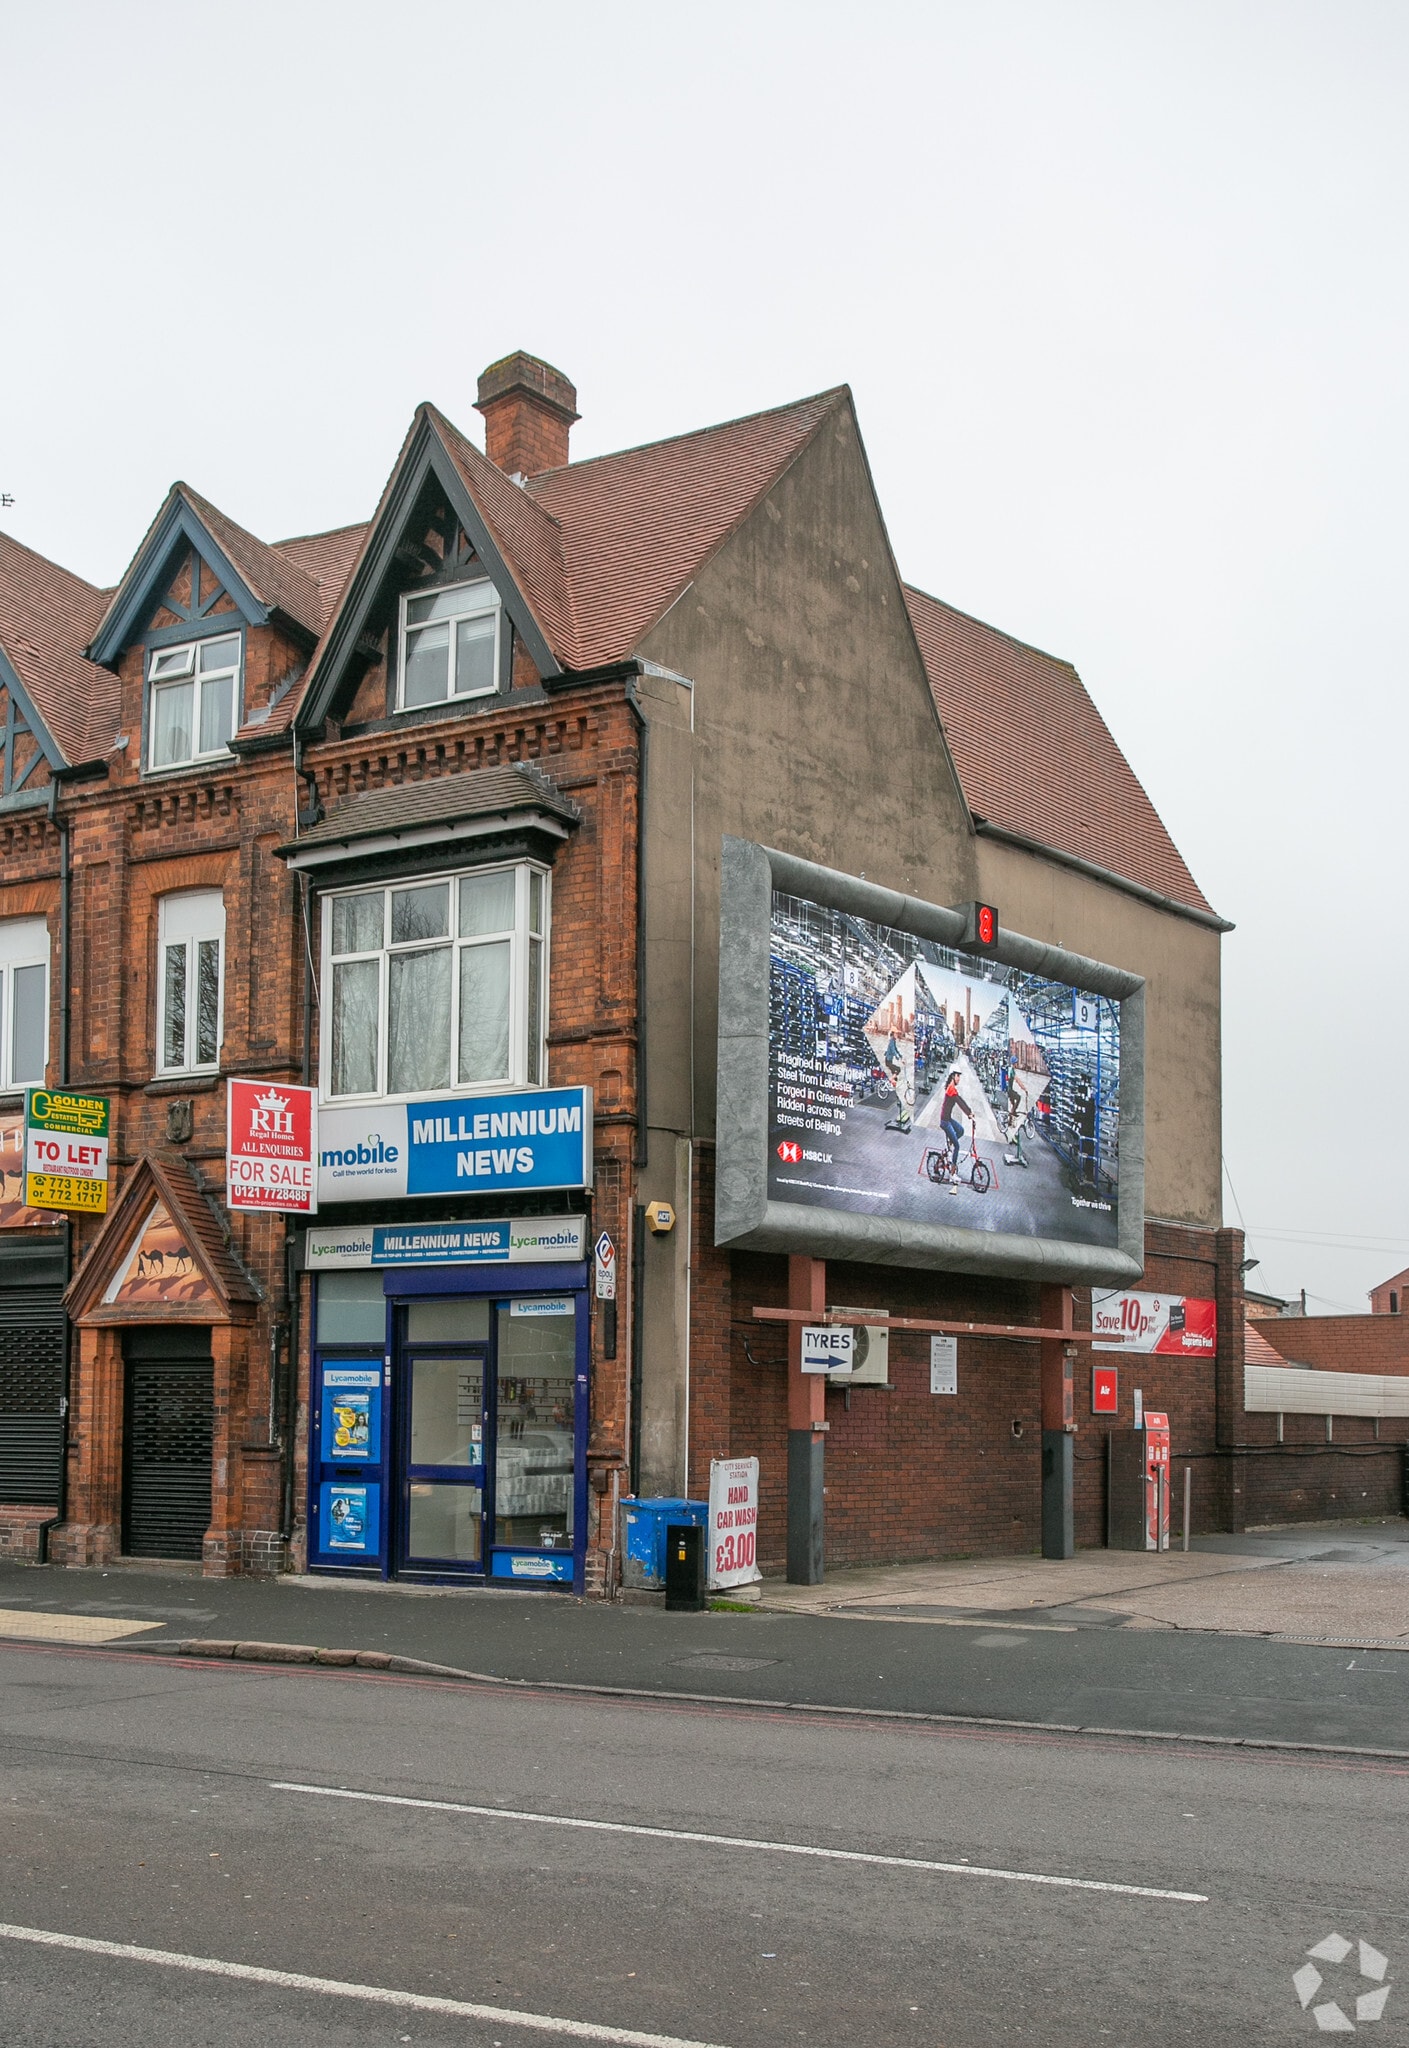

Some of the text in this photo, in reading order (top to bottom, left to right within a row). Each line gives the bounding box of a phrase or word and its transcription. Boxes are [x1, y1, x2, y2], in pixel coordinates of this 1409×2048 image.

[849, 971, 855, 984] 8
[1081, 1005, 1088, 1023] 9
[777, 1050, 814, 1069] Imagined
[815, 1059, 822, 1072] in
[777, 1066, 855, 1093] Steel from Leicester.
[777, 1081, 855, 1108] Forged in Greenford.
[53, 1095, 104, 1110] GOLDEN
[777, 1096, 846, 1120] Ridden across the
[51, 1113, 78, 1122] ESTATES
[250, 1108, 294, 1134] RH
[776, 1113, 842, 1136] streets of Beijing.
[44, 1122, 94, 1135] COMMERCIAL
[412, 1106, 581, 1145] MILLENNIUM
[249, 1130, 295, 1141] Regal Homes
[34, 1140, 103, 1166] TO LET
[241, 1142, 304, 1157] ALL ENQUIRIES
[802, 1149, 833, 1164] HSBC UK
[456, 1146, 534, 1177] NEWS
[229, 1160, 311, 1186] FOR SALE
[332, 1169, 345, 1178] Call
[356, 1168, 374, 1176] world
[49, 1177, 103, 1192] 773 7351
[33, 1189, 102, 1203] or 772 1717
[234, 1185, 307, 1202] 0121 7728488
[658, 1212, 669, 1221] ADT
[383, 1231, 501, 1250] MILLENNIUM NEWS
[510, 1232, 579, 1248] Lycamobile
[312, 1241, 372, 1256] Lycamobile
[598, 1269, 613, 1281] epay
[518, 1302, 567, 1313] Lycamobile
[1096, 1298, 1149, 1338] Save 10p
[804, 1332, 850, 1349] TYRES
[330, 1374, 373, 1383] Lycamobile
[1100, 1385, 1111, 1395] Air
[724, 1461, 753, 1471] CITY SERVICE
[729, 1470, 748, 1479] STATION
[727, 1486, 749, 1504] HAND
[717, 1507, 756, 1529] CAR WASH
[716, 1531, 755, 1573] £3.00
[511, 1559, 551, 1568] Lycamobile
